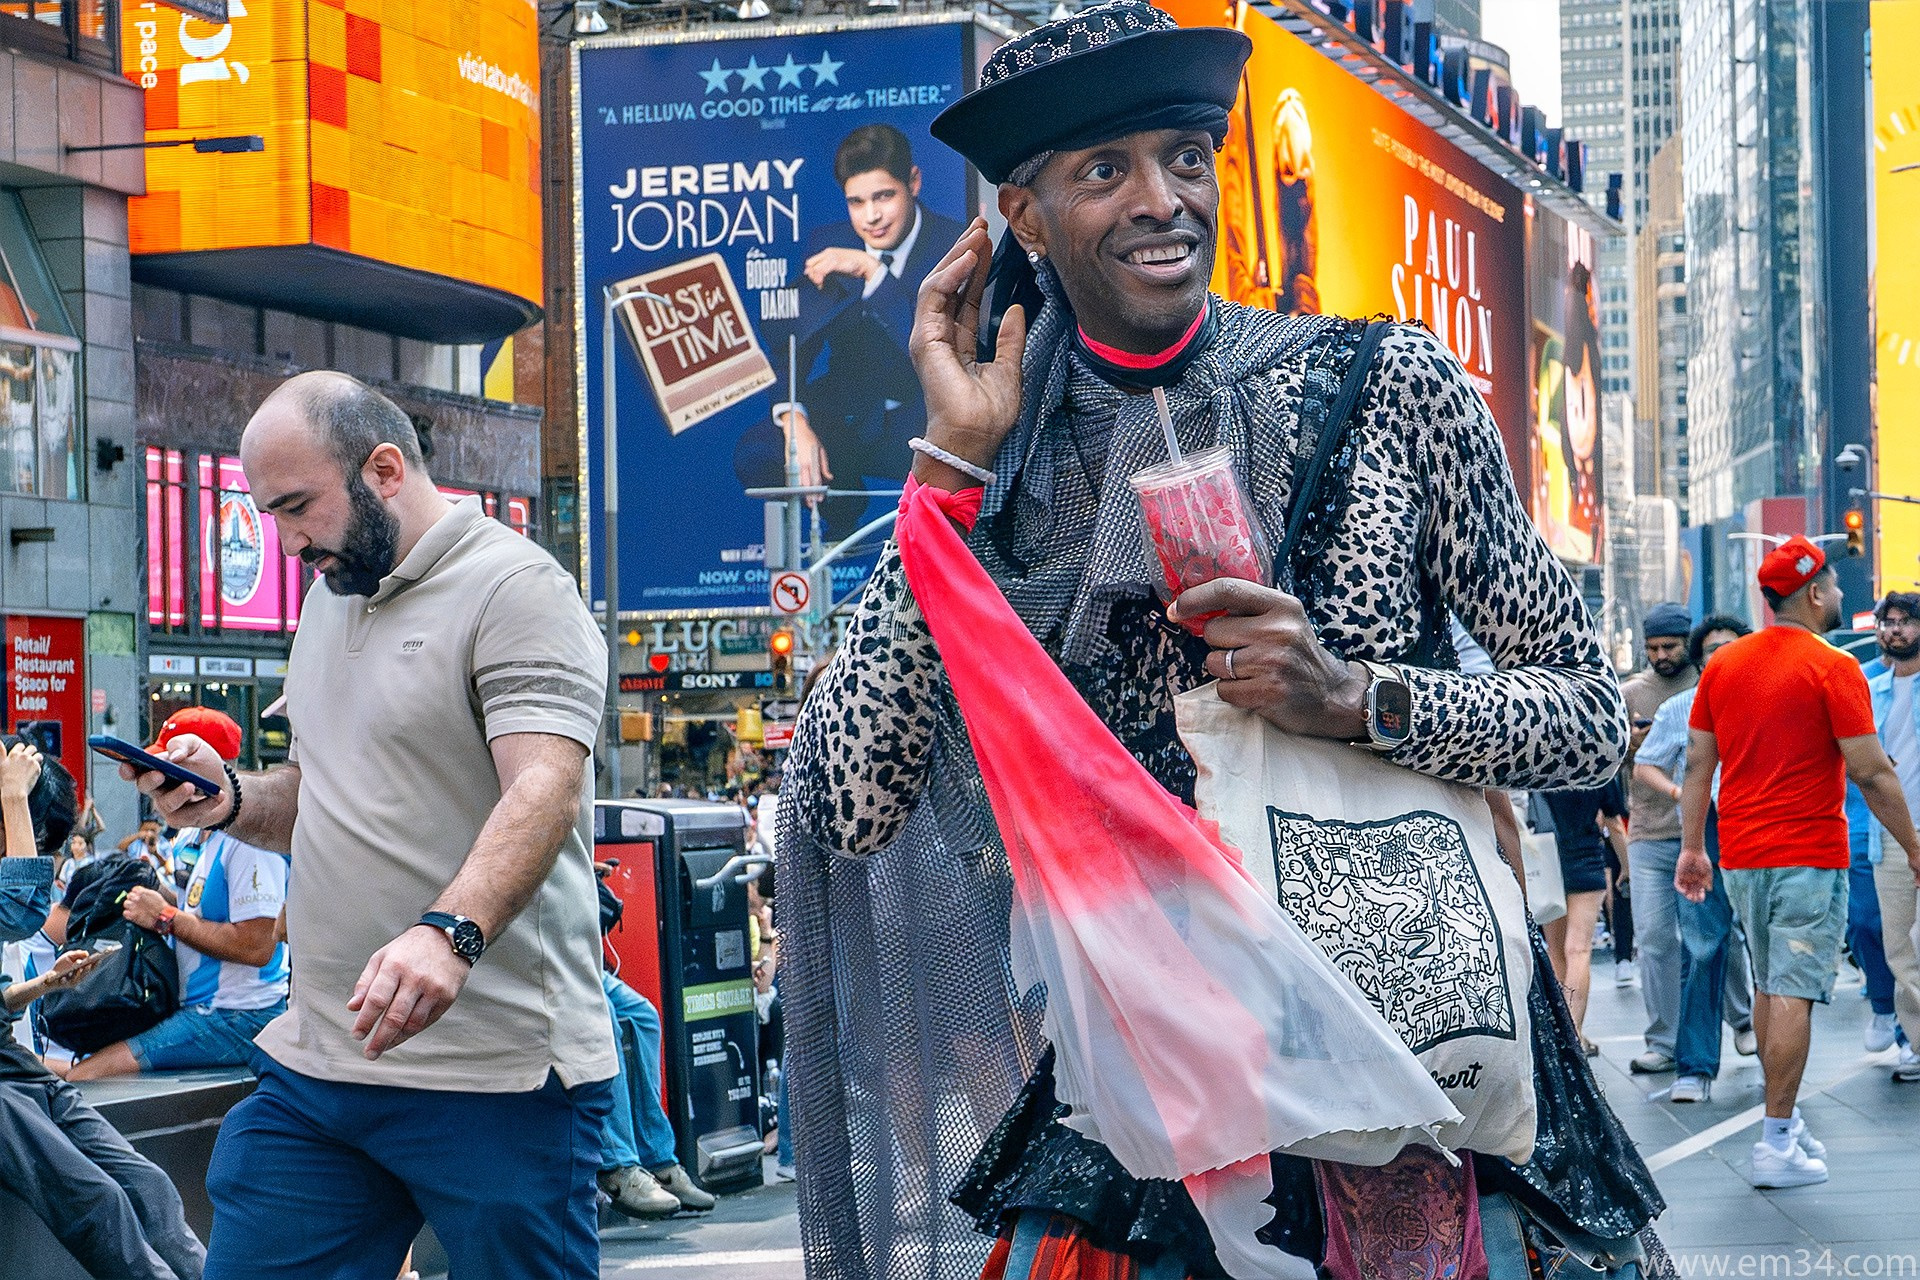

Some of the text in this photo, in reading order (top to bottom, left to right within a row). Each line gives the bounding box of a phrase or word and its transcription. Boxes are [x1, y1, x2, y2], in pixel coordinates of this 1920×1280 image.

[134, 21, 157, 88] pace
[622, 102, 697, 125] HELLUVA
[700, 97, 765, 120] GOOD
[769, 94, 810, 115] TIME
[834, 92, 866, 111] the
[609, 157, 805, 200] JEREMY
[611, 193, 799, 253] JORDAN
[1403, 194, 1481, 301] PAUL
[746, 258, 787, 290] BOBBY
[640, 283, 710, 338] JUST
[760, 287, 800, 321] DARIN
[1391, 263, 1494, 375] SIMON
[650, 311, 750, 369] TIME
[695, 400, 722, 416] NEW
[699, 569, 739, 585] NOW
[14, 634, 51, 657] Retail/
[15, 655, 75, 675] Restaurant
[681, 672, 743, 689] SONY
[15, 673, 67, 694] Space for
[15, 693, 48, 711] Lease
[685, 987, 752, 1014] TIMES SQUARE
